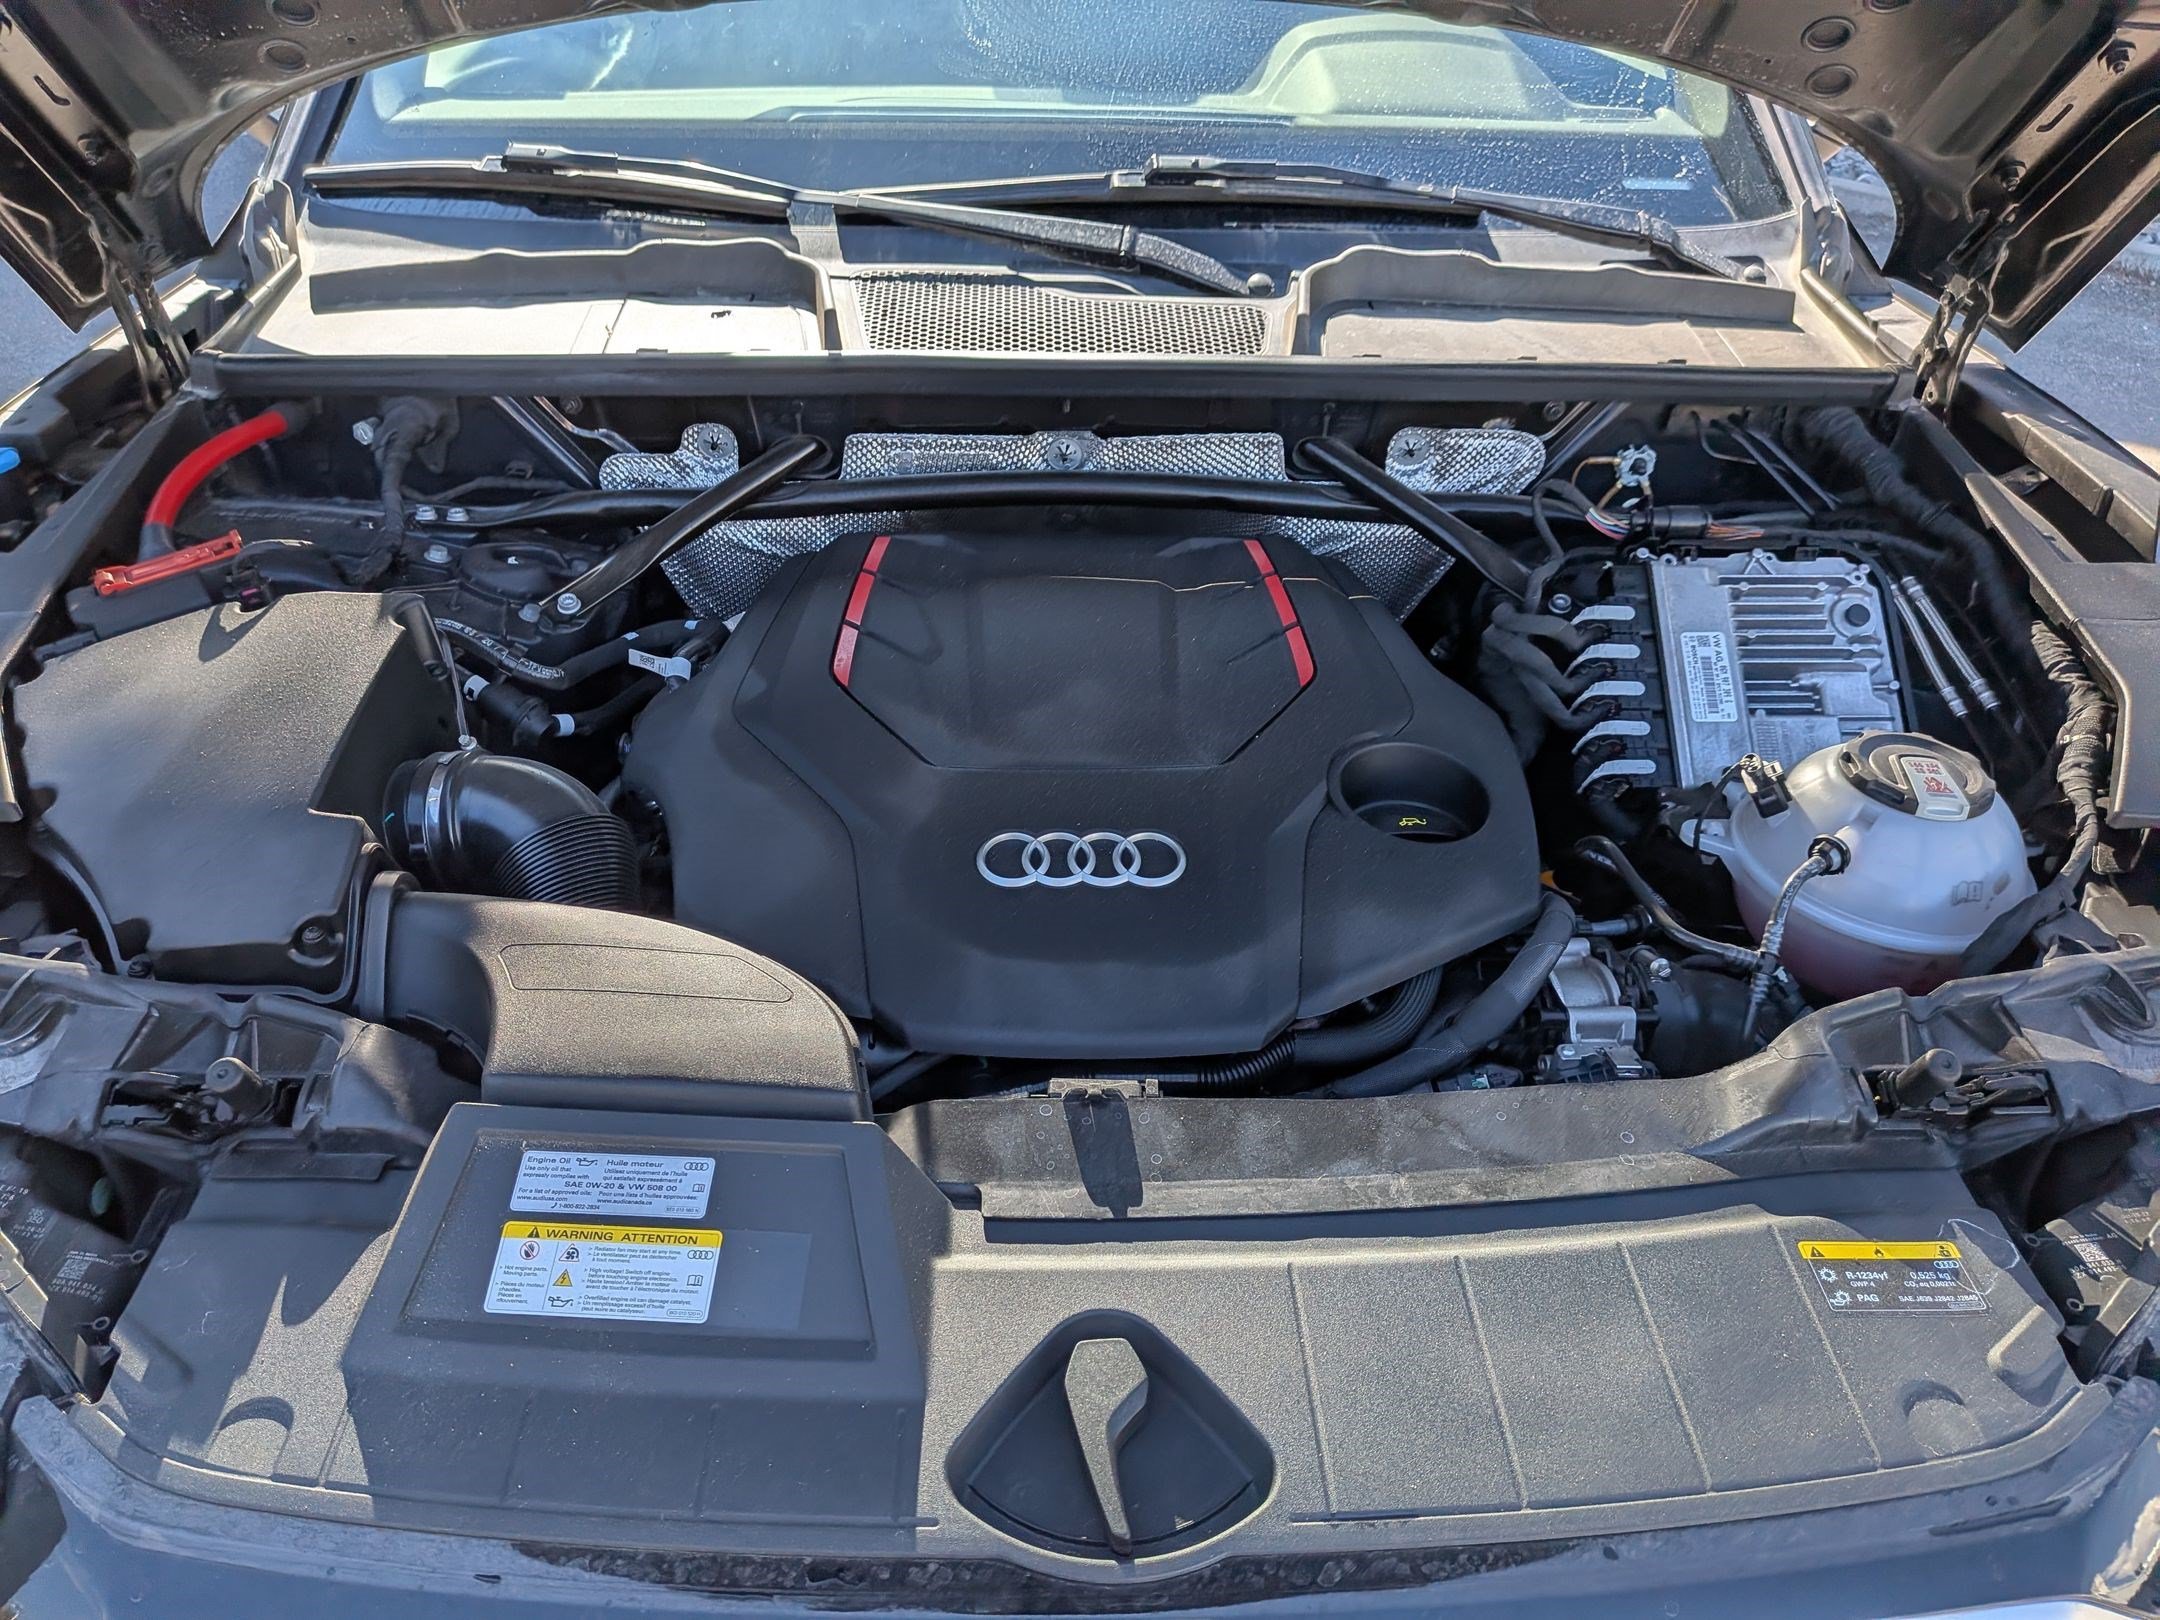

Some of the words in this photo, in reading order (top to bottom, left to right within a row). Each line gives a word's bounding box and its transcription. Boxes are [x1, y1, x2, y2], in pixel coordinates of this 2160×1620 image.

[1712, 634, 1721, 648] VW
[1690, 645, 1699, 665] BOSCH
[1715, 650, 1723, 663] AG
[546, 1229, 614, 1240] WARNING
[621, 1233, 698, 1244] ATTENTION
[1845, 1271, 1889, 1281] R-1234yf
[1910, 1272, 1936, 1280] 0,525
[1938, 1272, 1951, 1281] kg
[1857, 1294, 1879, 1302] PAG
